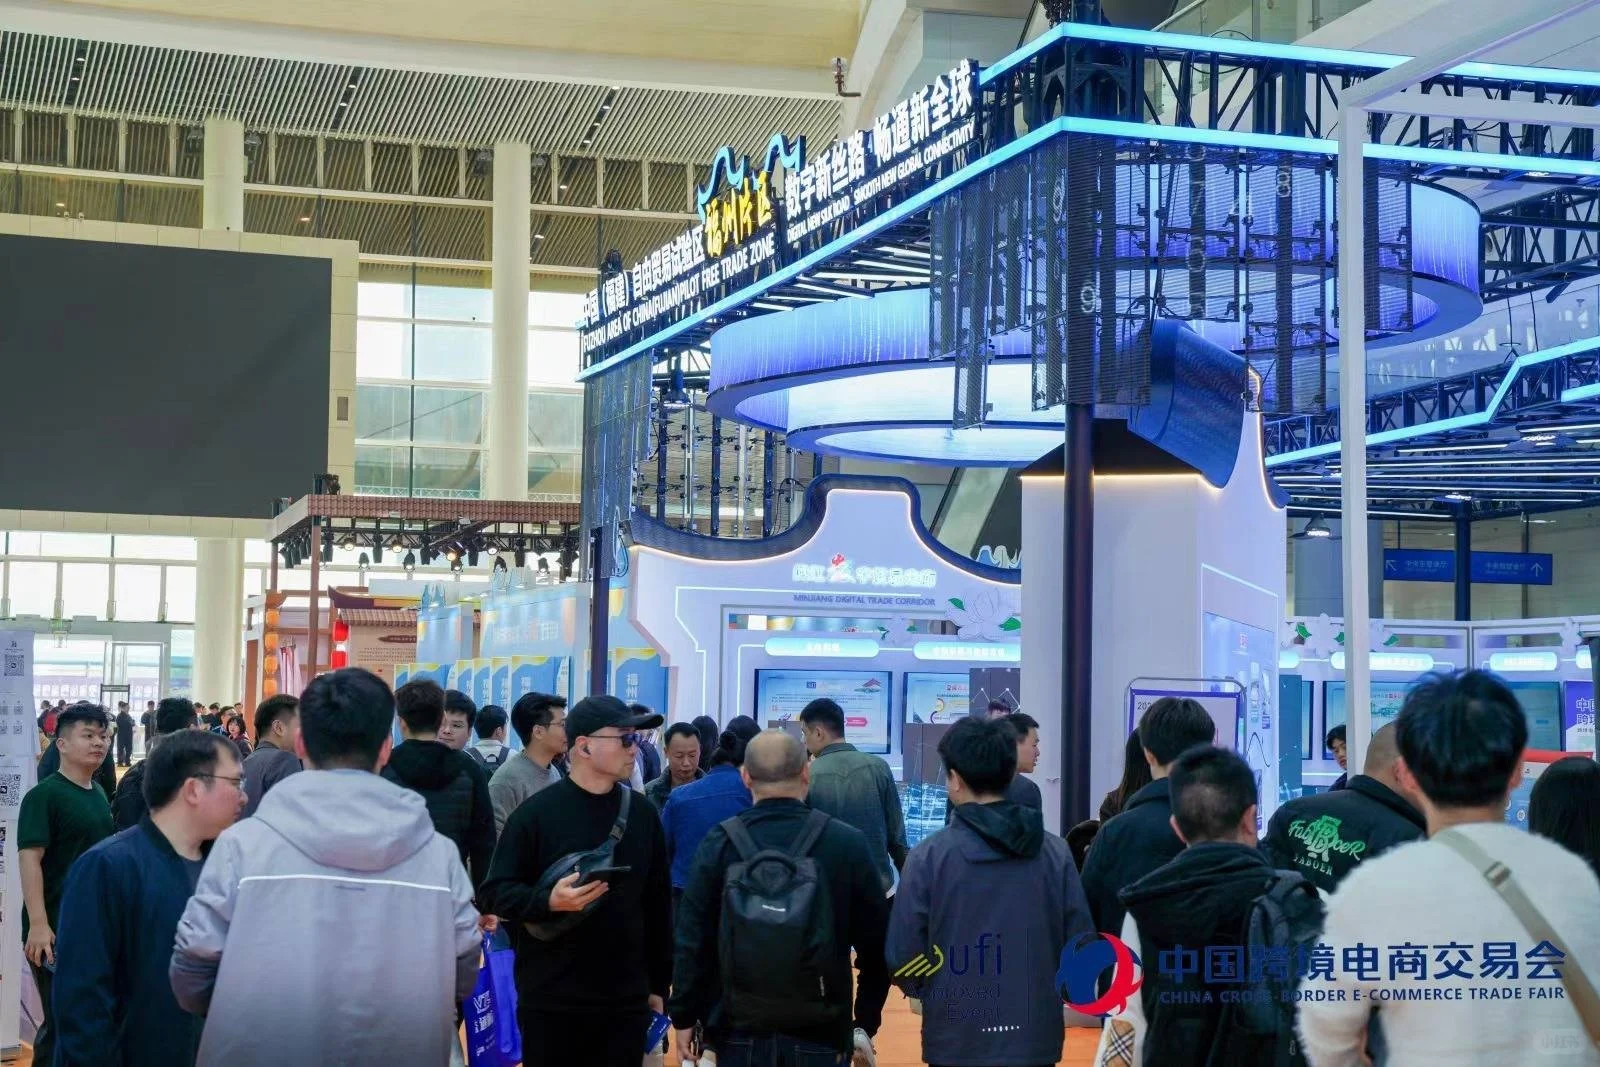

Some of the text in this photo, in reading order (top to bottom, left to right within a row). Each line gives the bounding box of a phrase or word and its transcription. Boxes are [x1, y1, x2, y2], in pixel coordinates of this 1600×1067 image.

[808, 213, 822, 233] NEW
[821, 206, 834, 225] SILK
[833, 195, 850, 218] ROAD
[854, 179, 881, 205] SMOOTH
[881, 167, 897, 192] NEW
[898, 153, 924, 180] GLOBAL
[923, 121, 976, 166] CONNECTIVITY
[583, 326, 607, 352] FUZHOU
[607, 318, 623, 342] AREA
[623, 310, 633, 333] OF
[701, 259, 721, 291] FREE
[720, 247, 749, 280] TRADE
[749, 231, 776, 266] ZONE
[792, 594, 936, 607] MINJIANG DIGITAL TRADE CORRIDOR
